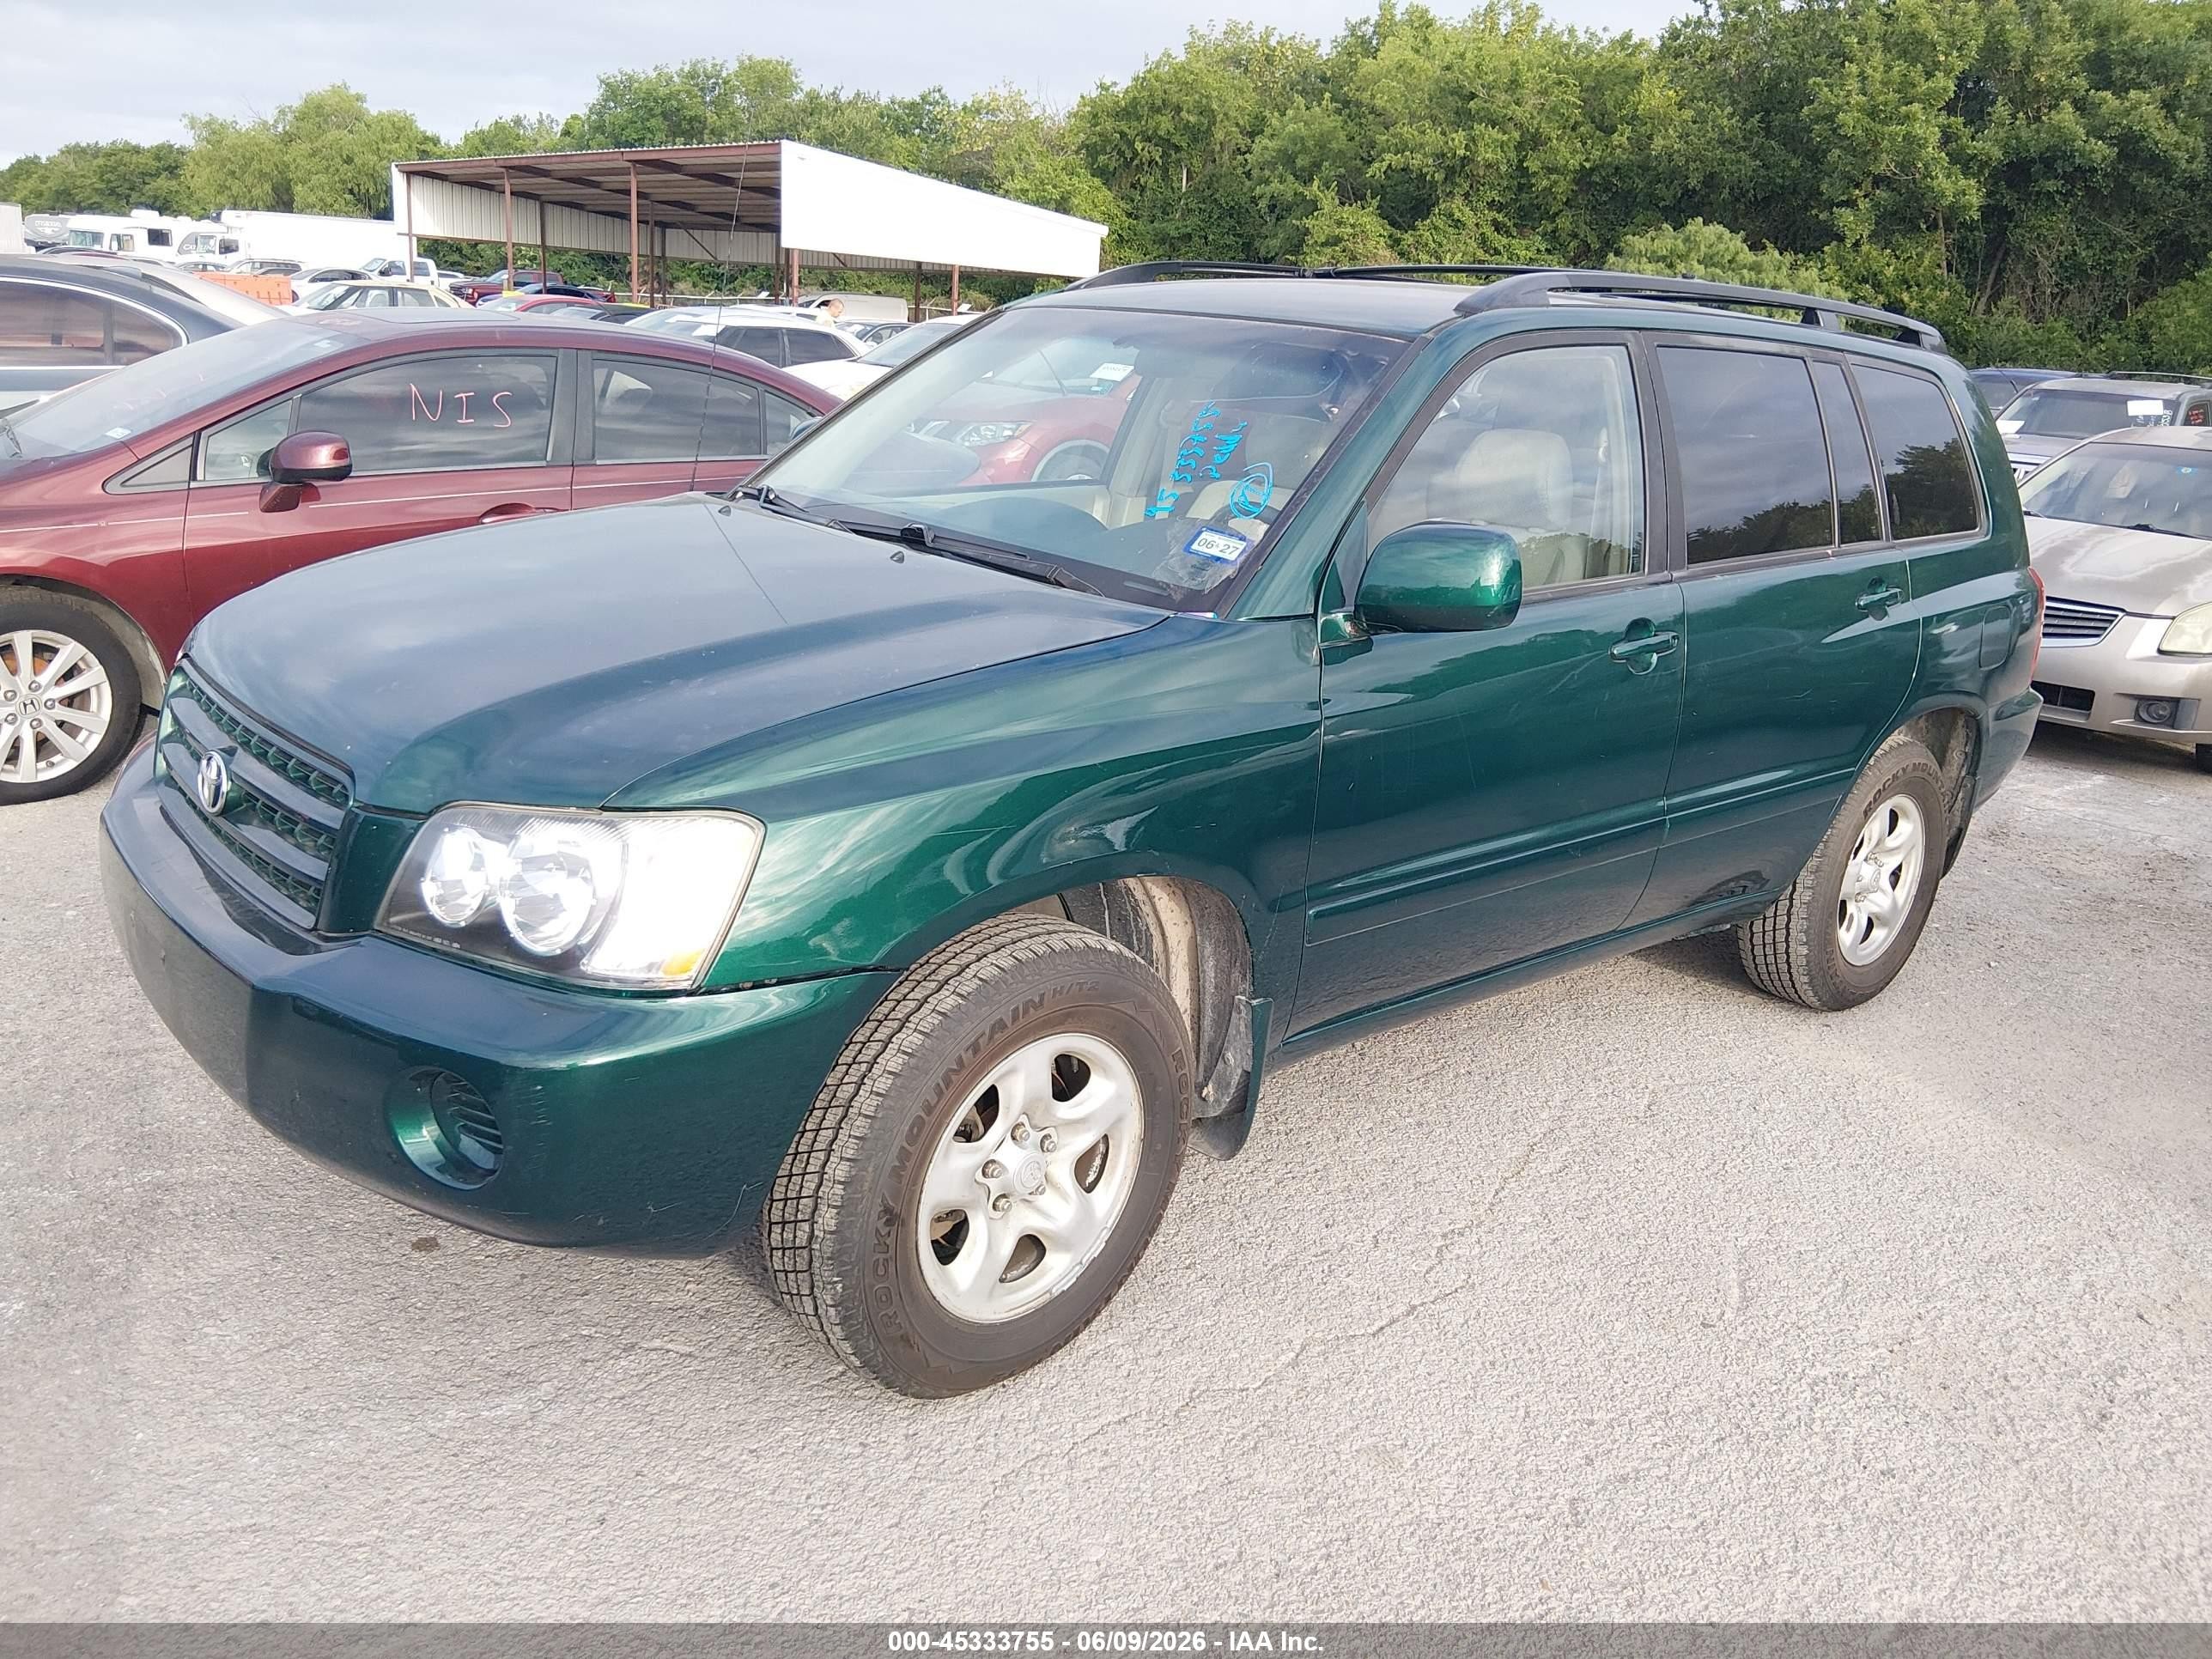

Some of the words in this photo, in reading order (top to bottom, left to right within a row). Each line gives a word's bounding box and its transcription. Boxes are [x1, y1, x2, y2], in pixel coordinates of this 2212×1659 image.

[410, 383, 513, 428] NIS
[1197, 538, 1216, 550] 06
[1219, 544, 1240, 556] 27
[1050, 979, 1100, 1000] H/T2
[887, 990, 1046, 1185] MOUNTAIN
[872, 1192, 903, 1334] ROCKY
